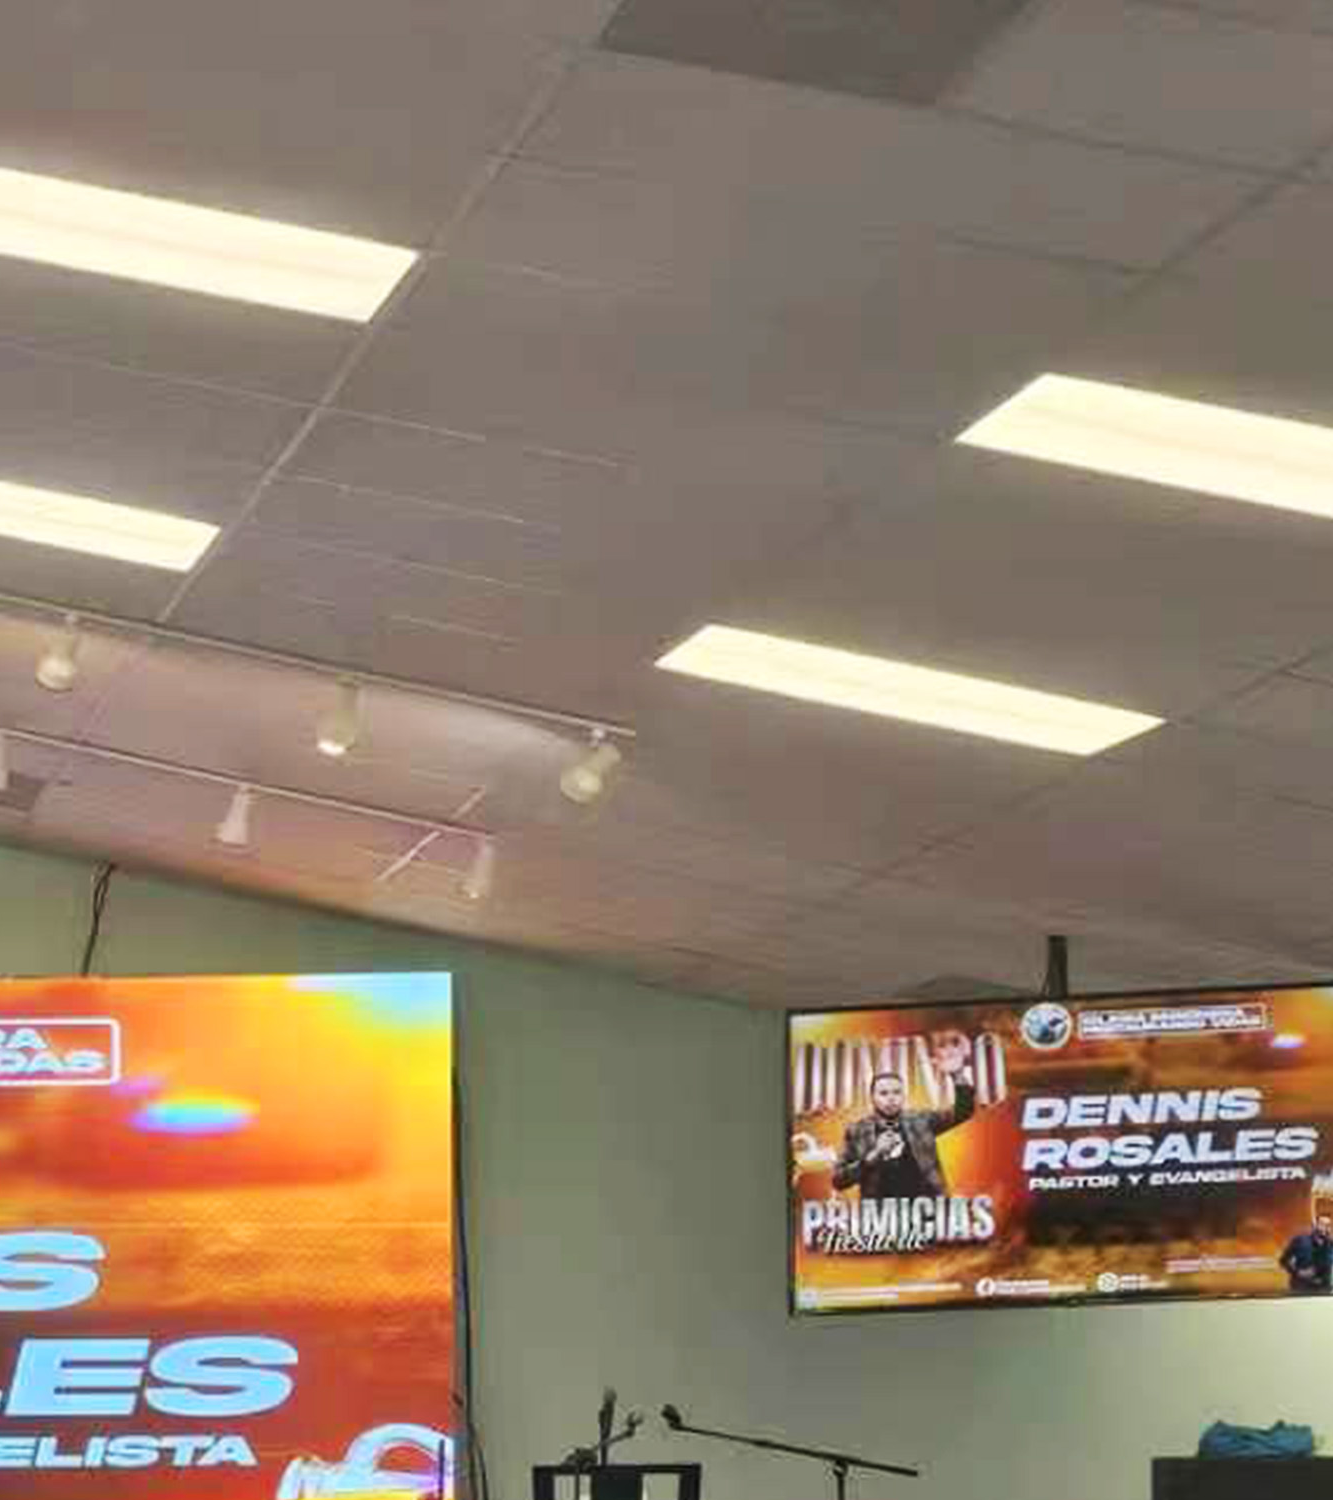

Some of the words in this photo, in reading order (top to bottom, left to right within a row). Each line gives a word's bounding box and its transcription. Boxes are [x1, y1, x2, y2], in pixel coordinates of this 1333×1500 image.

[1021, 1086, 1263, 1130] DENNIS
[1021, 1126, 1320, 1171] ROSALES
[1029, 1172, 1119, 1192] PASTOR
[1128, 1172, 1145, 1187] Y
[1148, 1166, 1307, 1187] EVANGELISTA
[802, 1195, 996, 1247] PRIMICIAS
